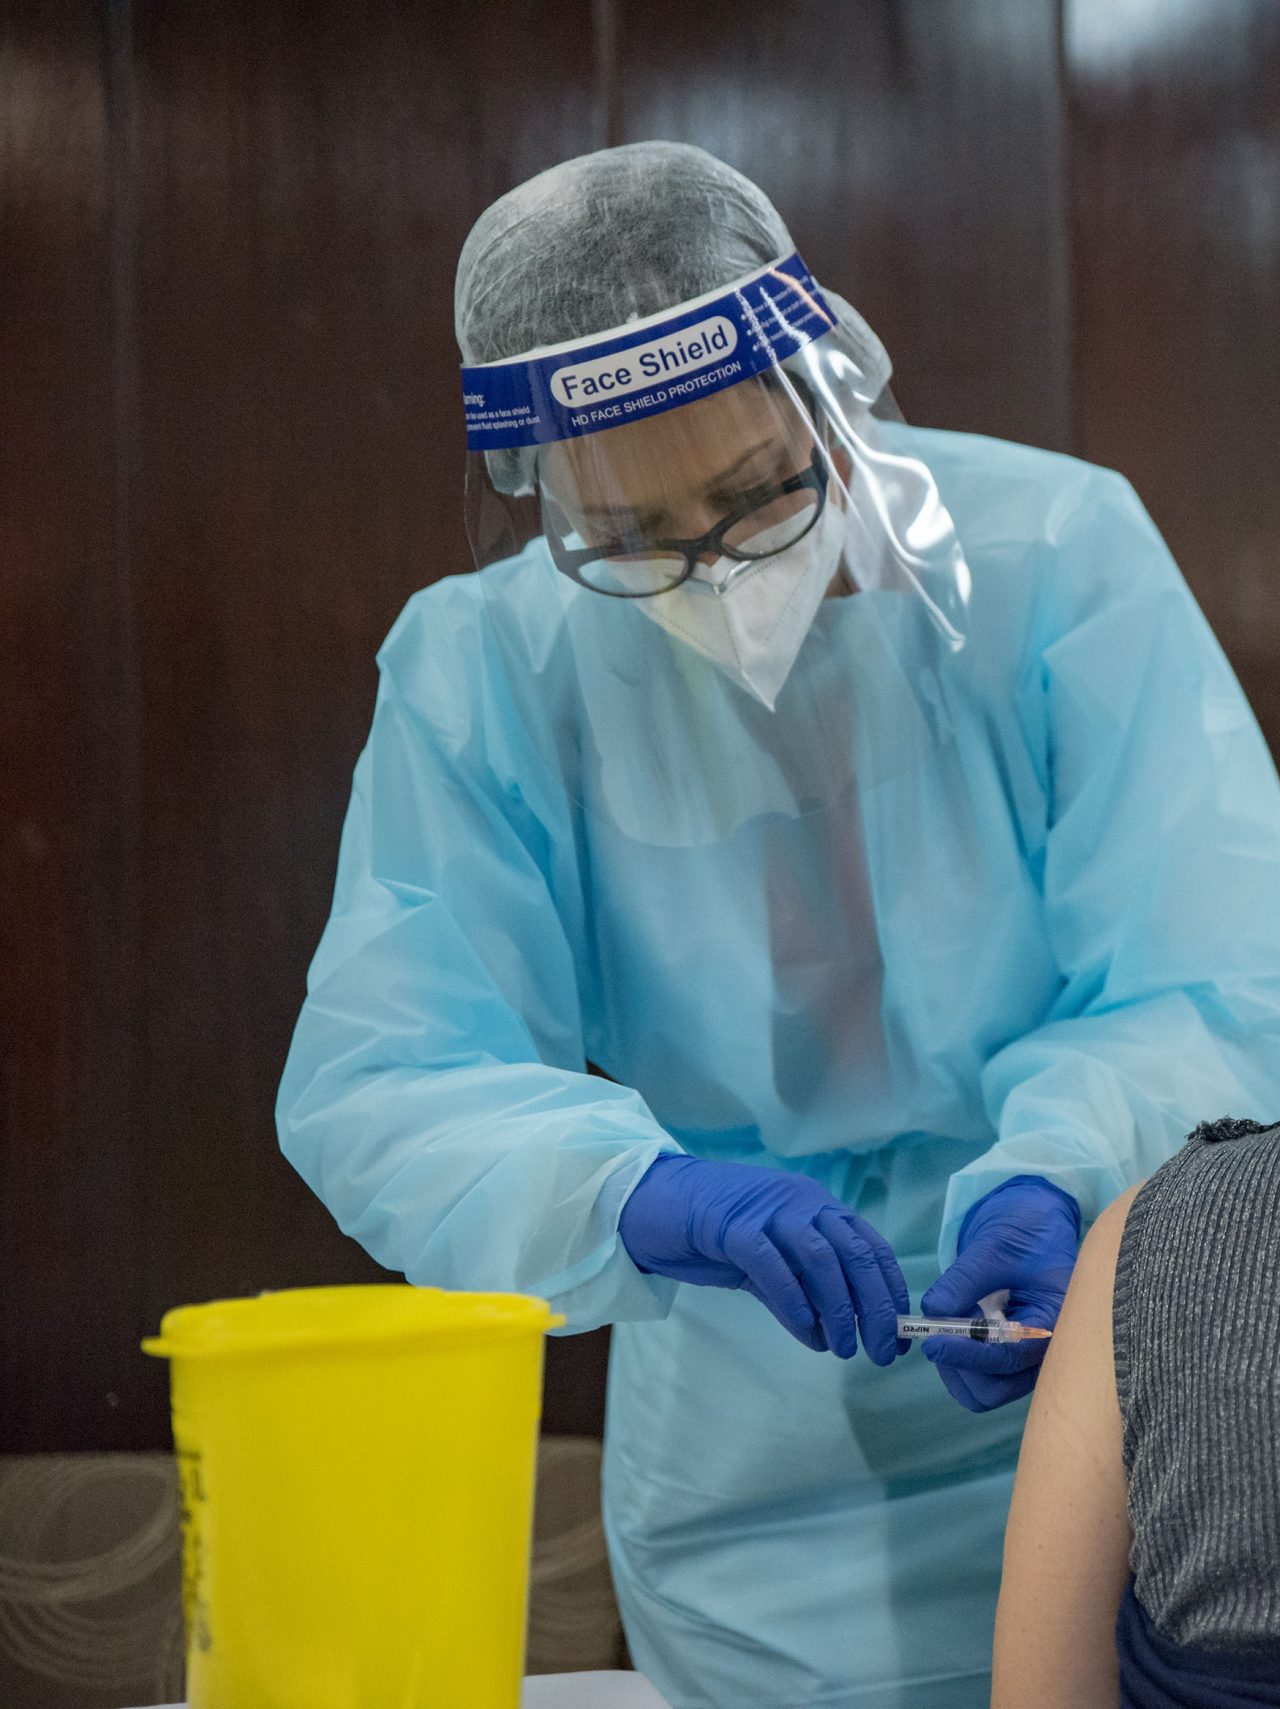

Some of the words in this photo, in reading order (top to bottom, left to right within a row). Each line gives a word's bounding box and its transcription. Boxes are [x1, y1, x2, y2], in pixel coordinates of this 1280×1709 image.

[561, 366, 632, 400] Face
[638, 324, 729, 377] Shield
[571, 414, 589, 427] HD
[591, 406, 622, 423] FACE
[624, 391, 667, 413] SHIELD
[669, 360, 742, 398] PROTECTION
